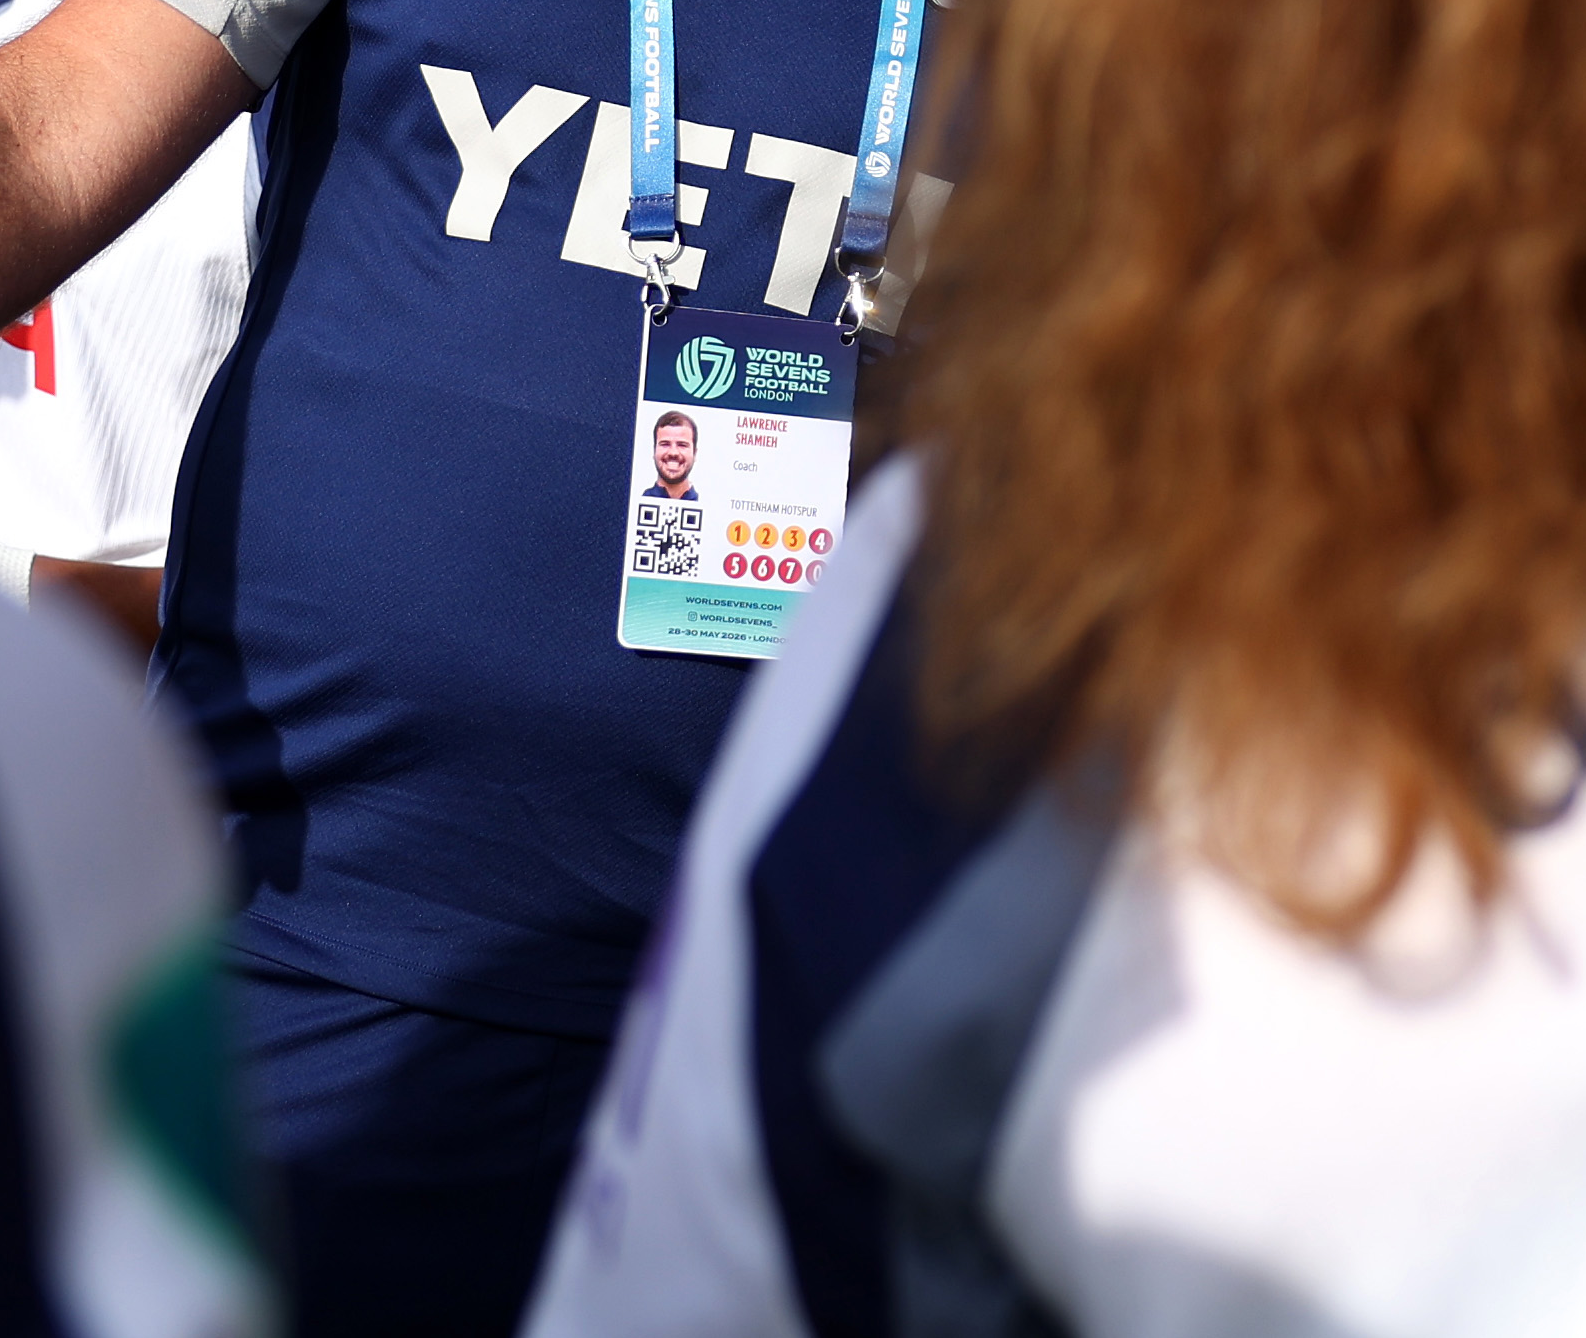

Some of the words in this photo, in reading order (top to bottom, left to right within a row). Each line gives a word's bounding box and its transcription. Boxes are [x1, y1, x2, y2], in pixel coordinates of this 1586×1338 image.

[644, 26, 661, 153] FOOTBALL
[874, 59, 903, 145] WORLD
[745, 346, 824, 368] WORLD
[745, 362, 831, 383] SEVENS
[744, 387, 794, 402] LONDON
[745, 376, 828, 395] FOOTBALL
[737, 416, 788, 432] LAWRENCE
[735, 432, 778, 448] SHAMIEH
[733, 460, 758, 472] Coach
[730, 499, 780, 514] TOTTENHAM
[781, 504, 818, 517] HOTSPUR
[734, 524, 742, 542] 1
[761, 527, 771, 545] 2
[789, 529, 798, 548] 3
[815, 532, 826, 551] 4
[730, 556, 740, 575] 5
[757, 559, 768, 578] 6
[785, 561, 796, 580] 7
[685, 596, 783, 611] WORLDSEVENS.COM
[668, 627, 698, 637] 28-30
[699, 629, 720, 639] MAY
[721, 632, 747, 641] 2026
